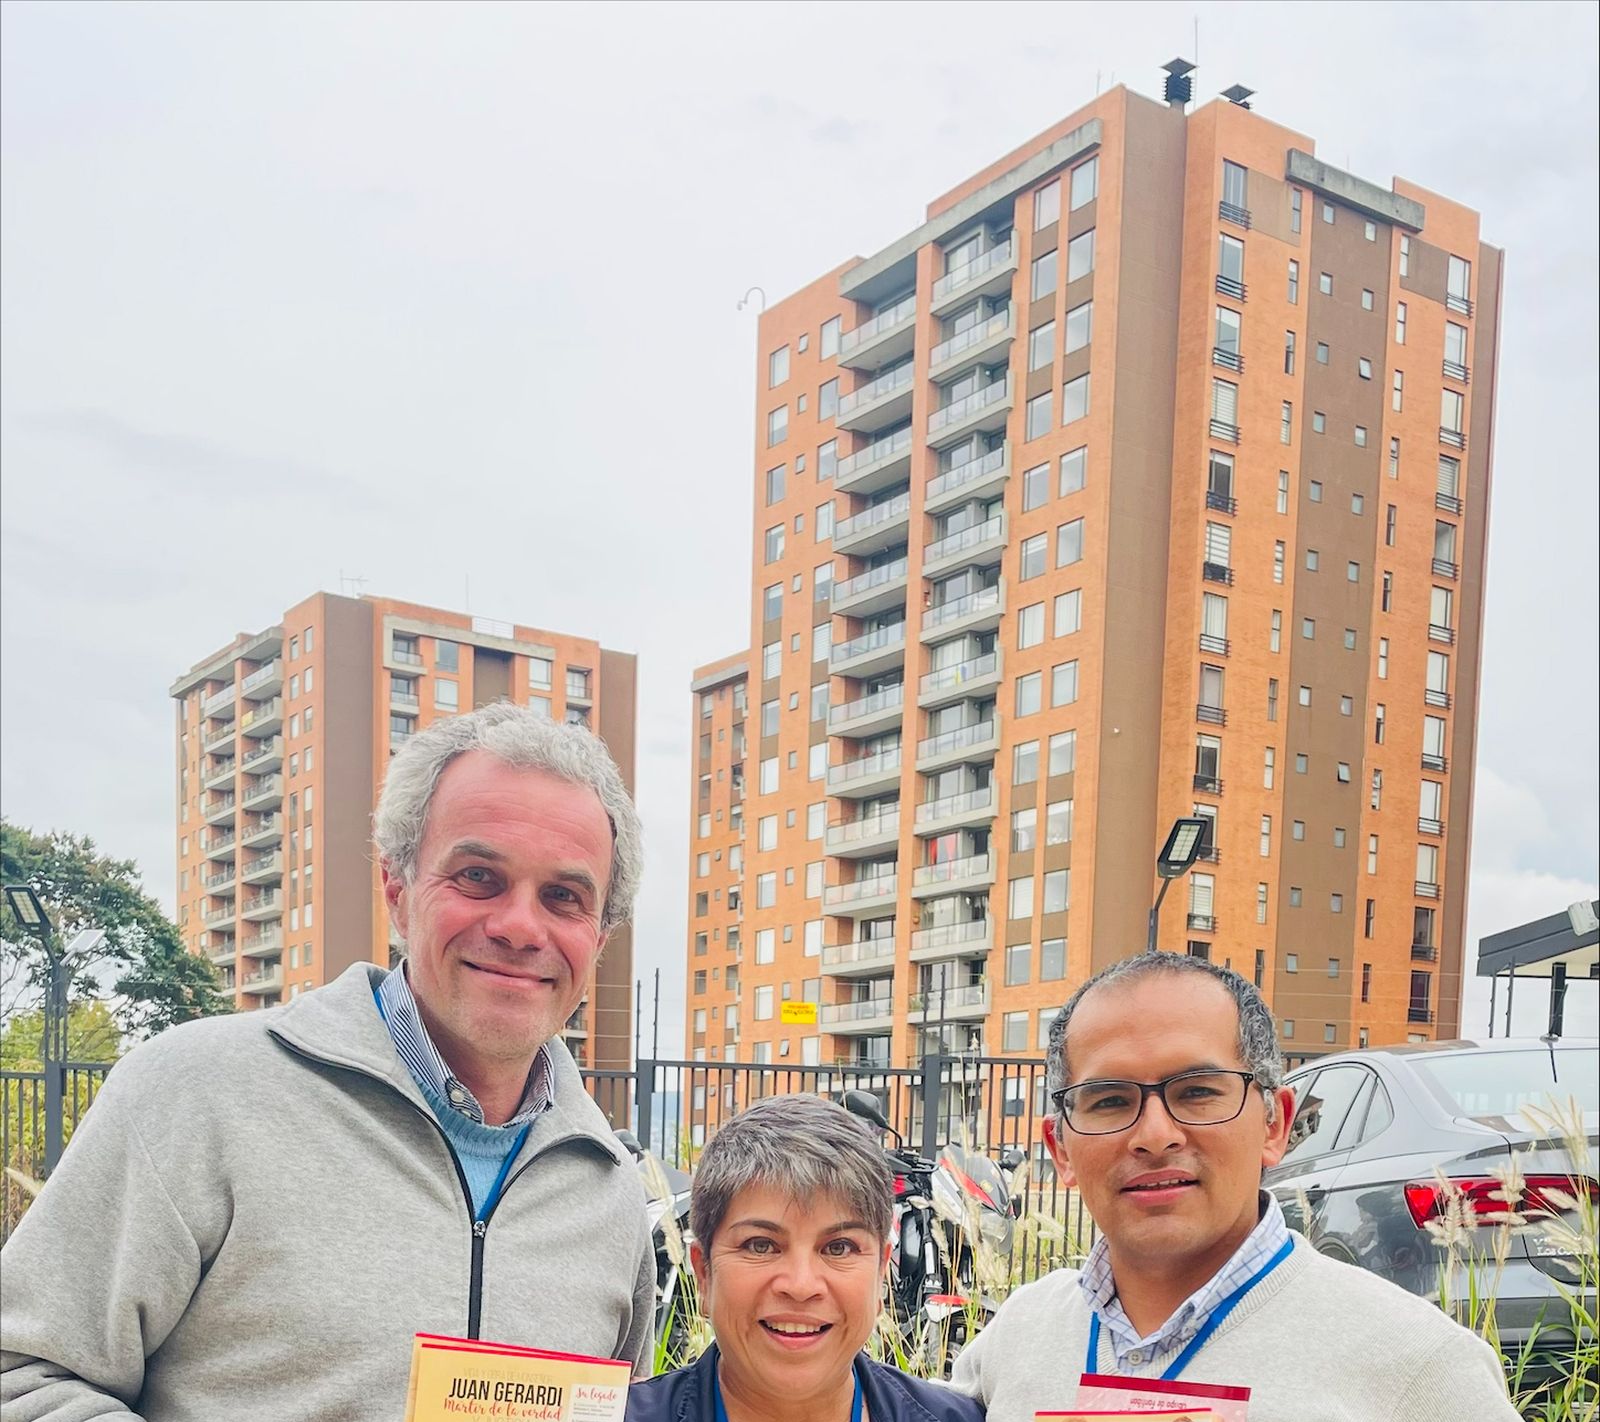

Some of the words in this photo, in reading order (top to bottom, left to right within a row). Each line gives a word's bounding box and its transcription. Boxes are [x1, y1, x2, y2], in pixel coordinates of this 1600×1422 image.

[448, 1378, 490, 1400] JUAN
[494, 1381, 563, 1407] GERARDI
[590, 1387, 617, 1404] legado
[489, 1401, 504, 1416] de
[506, 1401, 518, 1417] la
[522, 1405, 563, 1422] verdad
